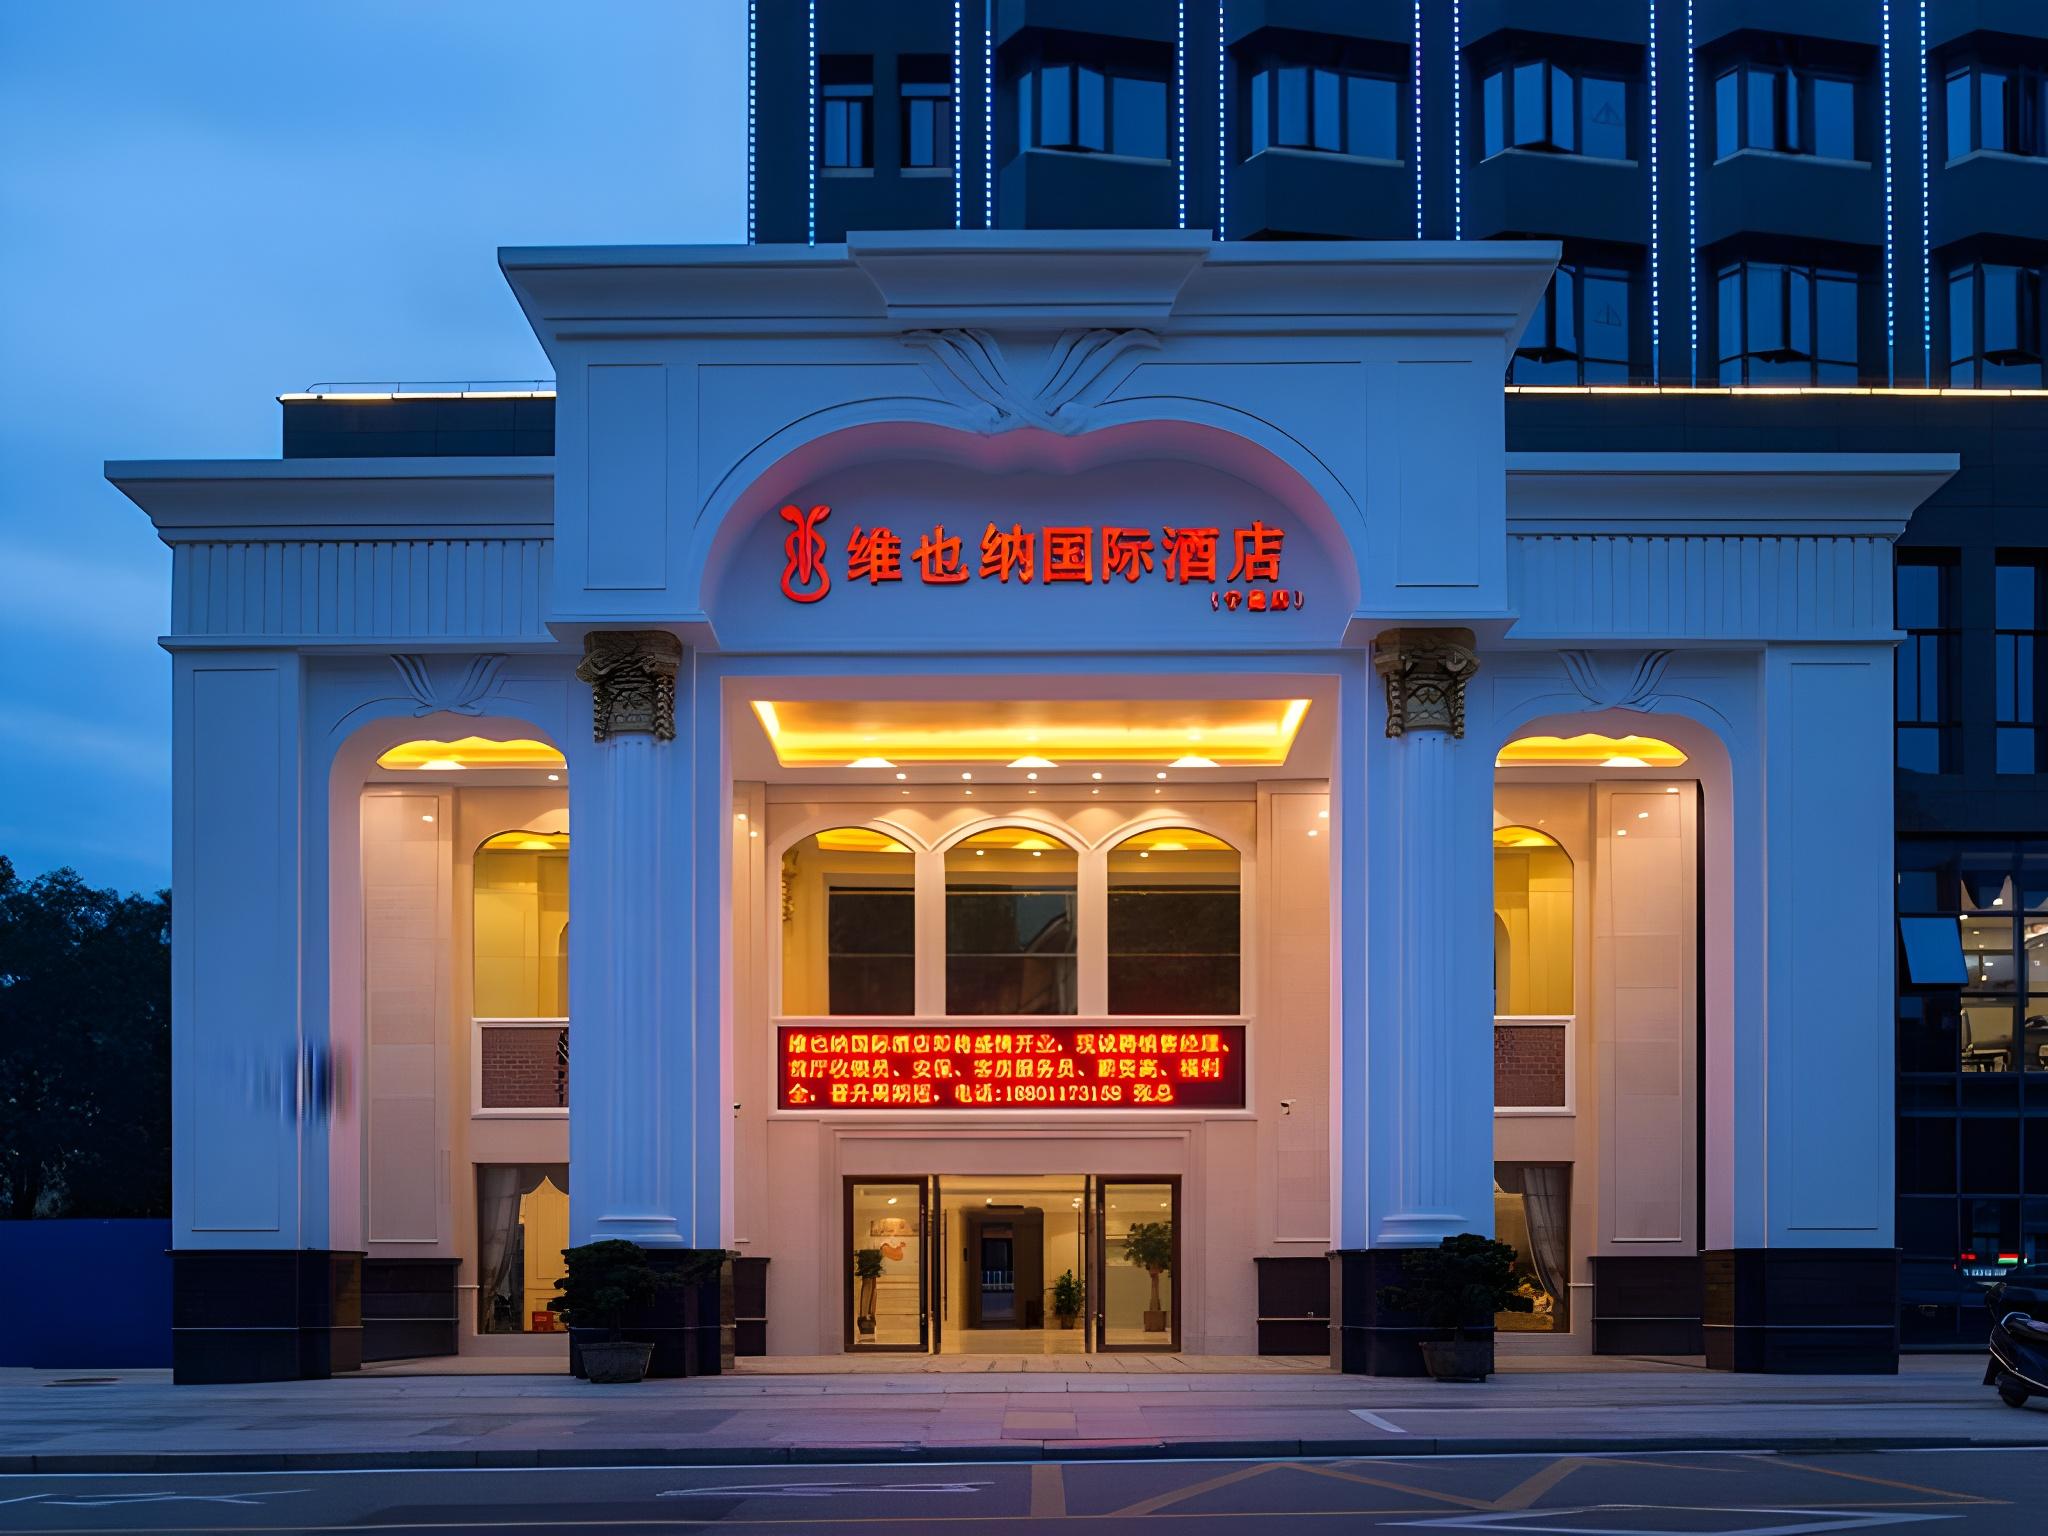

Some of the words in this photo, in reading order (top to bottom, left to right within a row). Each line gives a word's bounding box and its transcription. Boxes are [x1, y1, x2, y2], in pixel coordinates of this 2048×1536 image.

[846, 520, 1285, 585] 维也纳国际酒店
